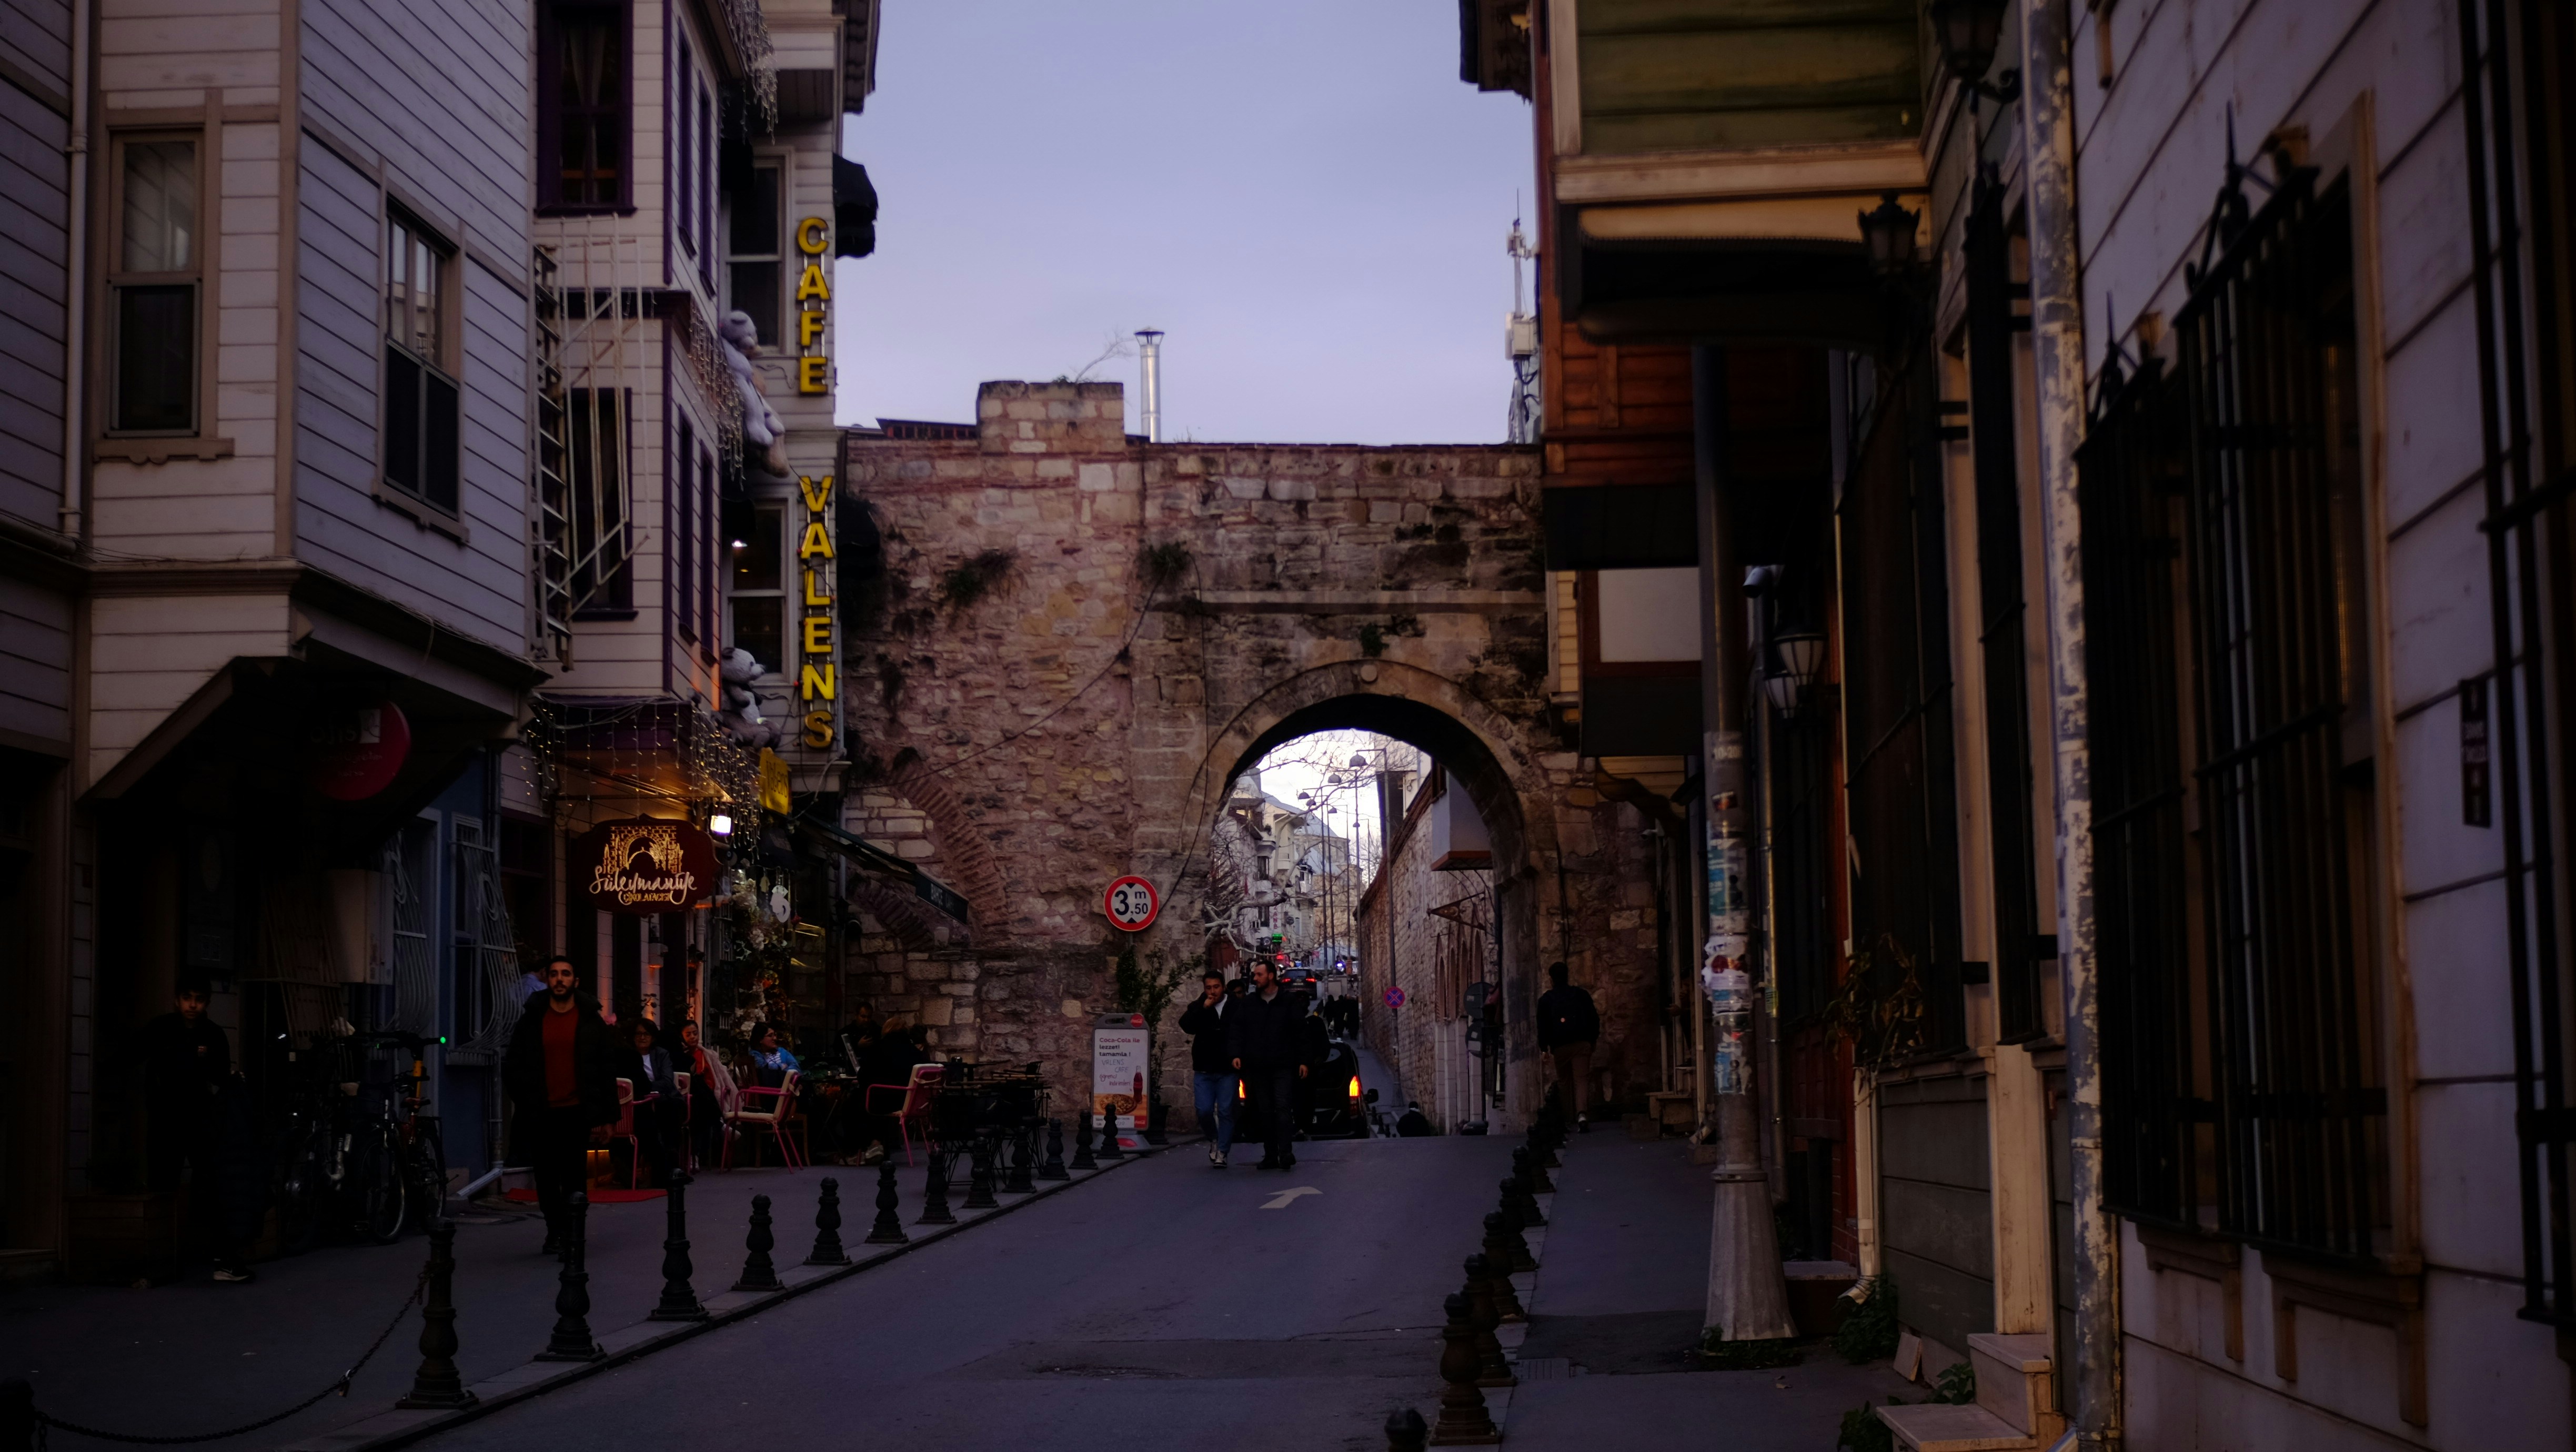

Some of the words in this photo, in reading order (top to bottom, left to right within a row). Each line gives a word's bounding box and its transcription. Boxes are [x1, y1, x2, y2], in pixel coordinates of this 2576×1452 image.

[797, 217, 831, 395] CAFE
[799, 476, 836, 750] VALENS
[1115, 890, 1129, 915] 3
